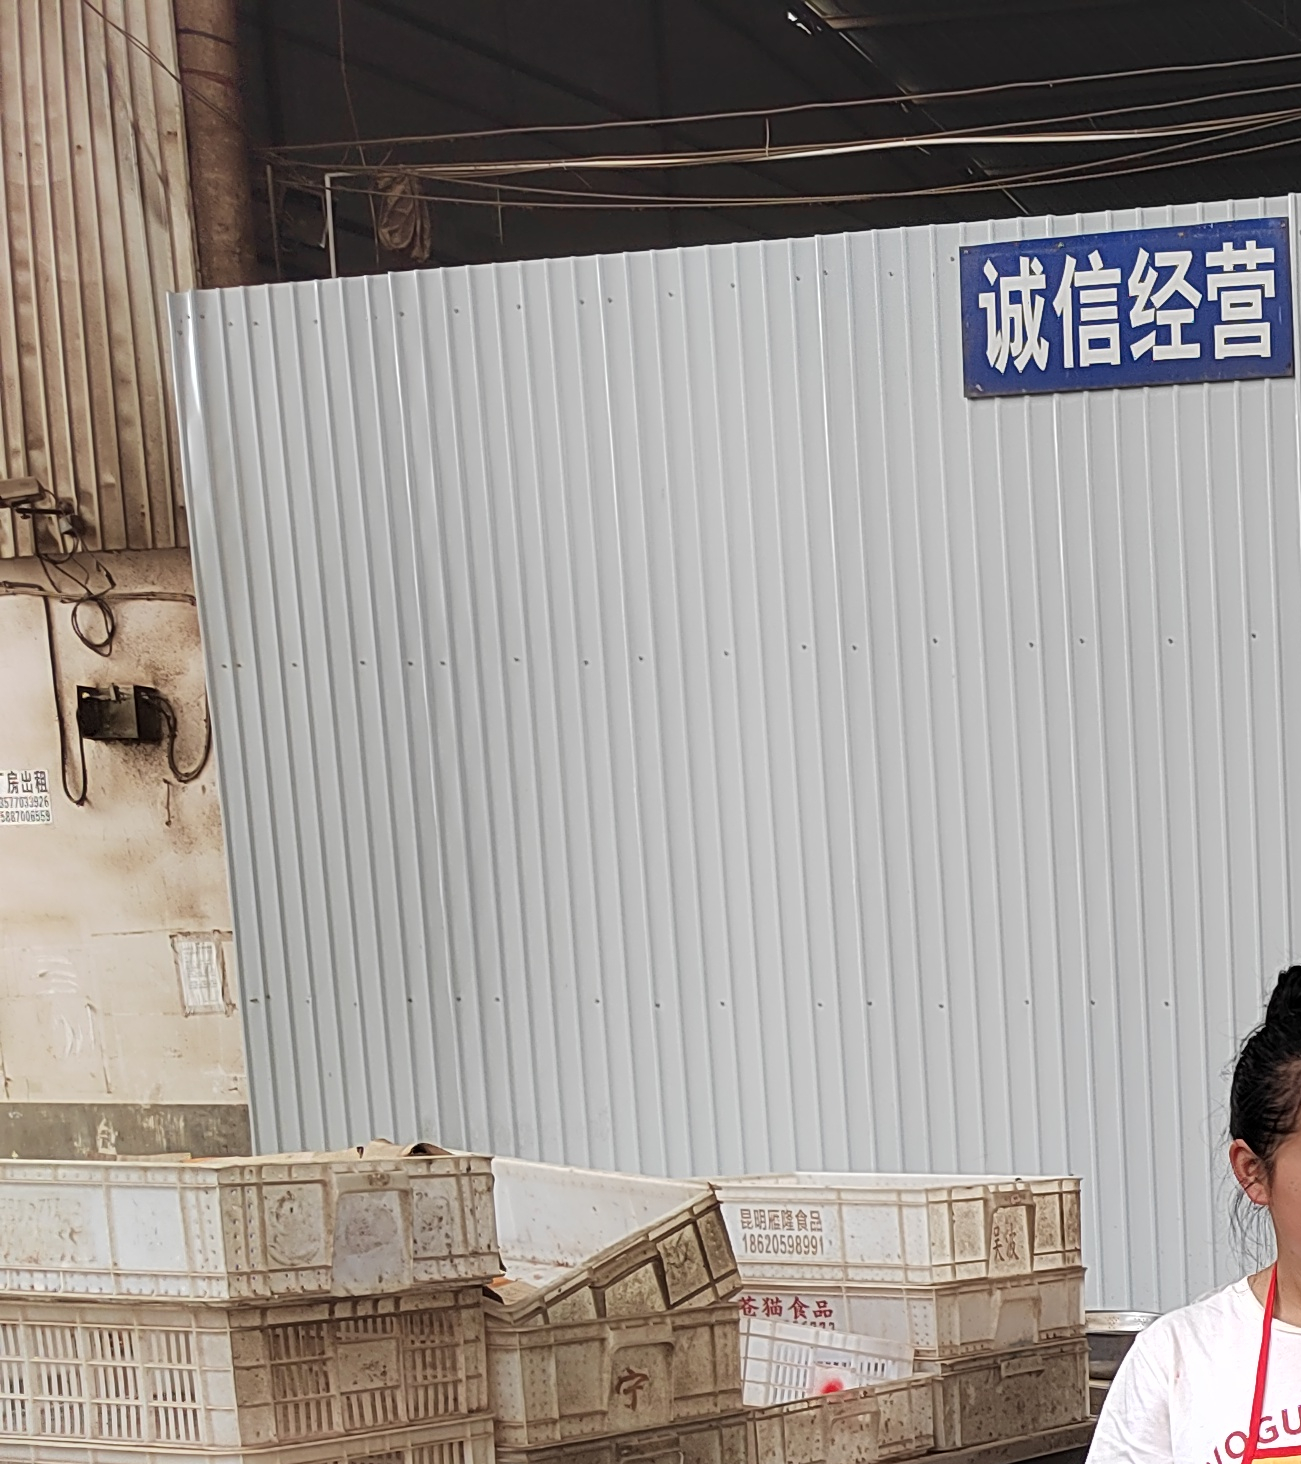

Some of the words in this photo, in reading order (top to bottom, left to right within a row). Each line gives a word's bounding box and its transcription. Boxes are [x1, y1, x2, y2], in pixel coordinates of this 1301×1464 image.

[979, 240, 1276, 373] 诚信经营
[0, 770, 48, 794] 房出租
[742, 1233, 824, 1255] 18620598991
[739, 1296, 834, 1320] 苍猫食品
